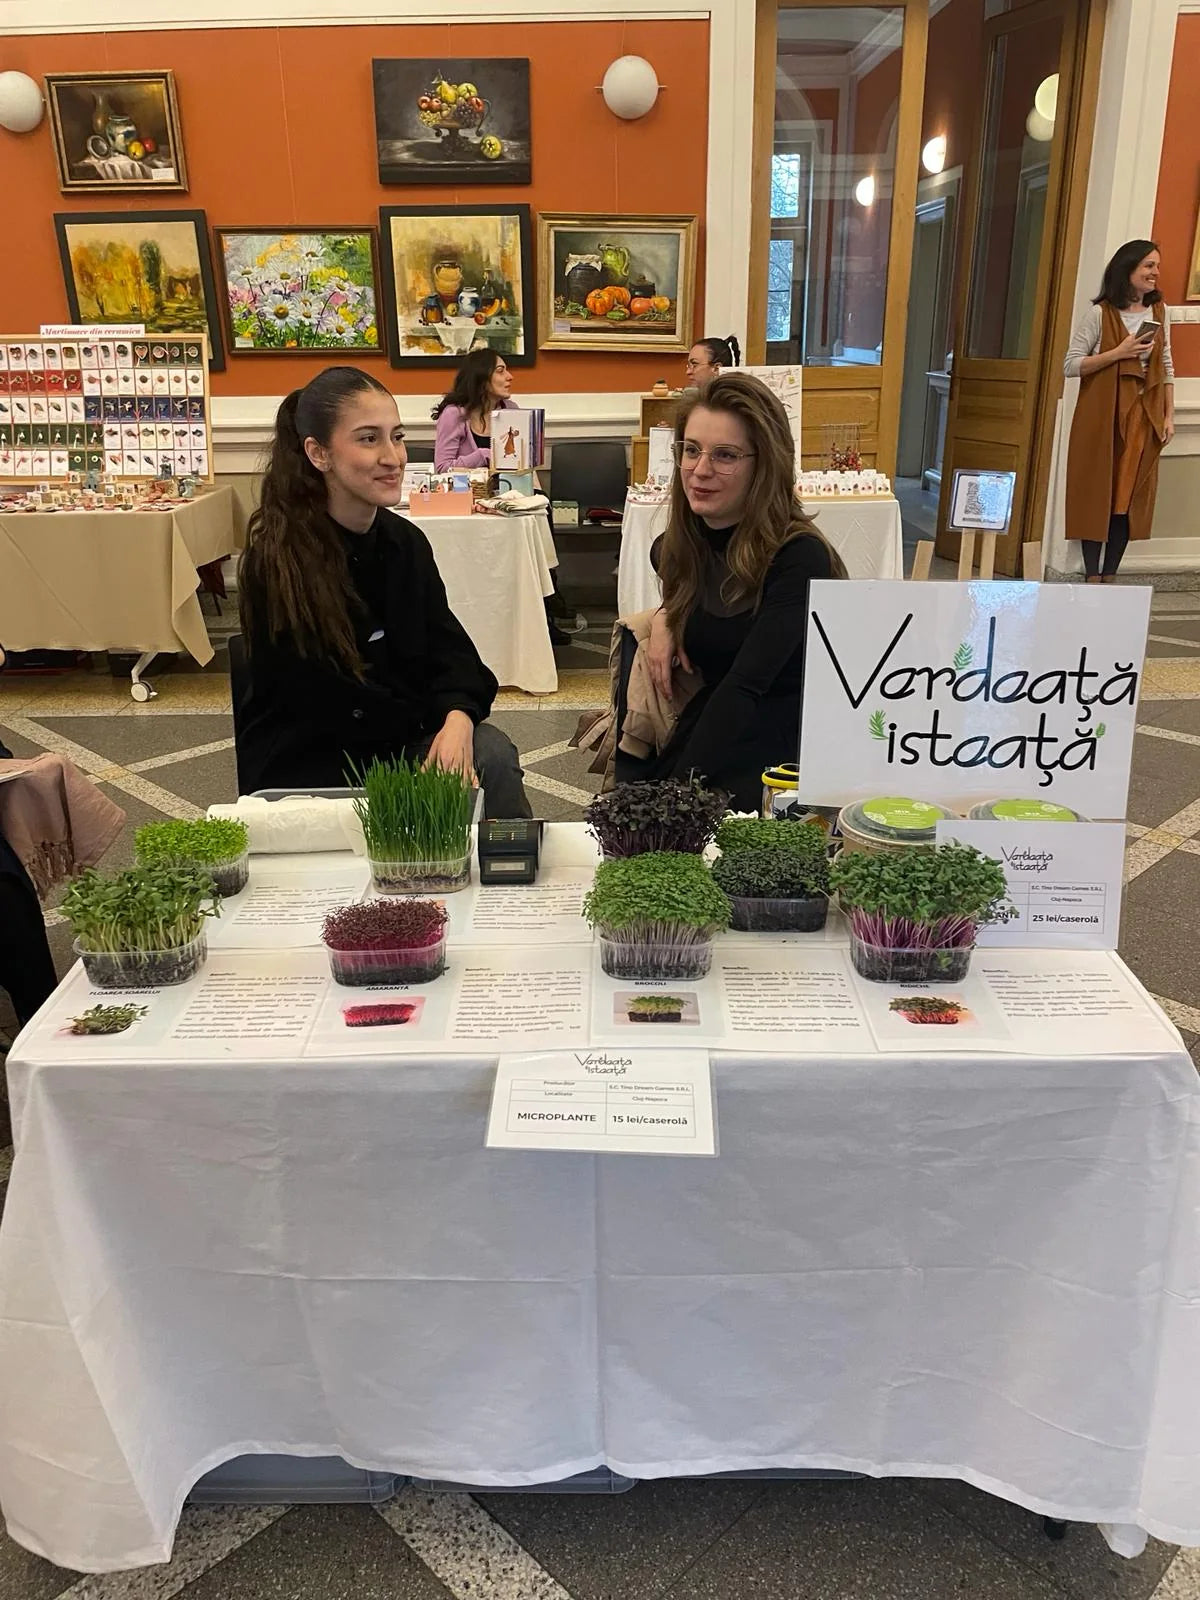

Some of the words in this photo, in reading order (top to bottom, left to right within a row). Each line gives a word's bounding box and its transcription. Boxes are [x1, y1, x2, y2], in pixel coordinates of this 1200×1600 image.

[811, 610, 1138, 722] Verdeață
[888, 709, 1098, 787] isteață
[1032, 914, 1045, 922] 25
[1046, 914, 1099, 924] lei/caserolă
[517, 1112, 597, 1122] MICROPLANTE
[612, 1115, 624, 1123] 15
[626, 1115, 688, 1125] lei/caserolă
